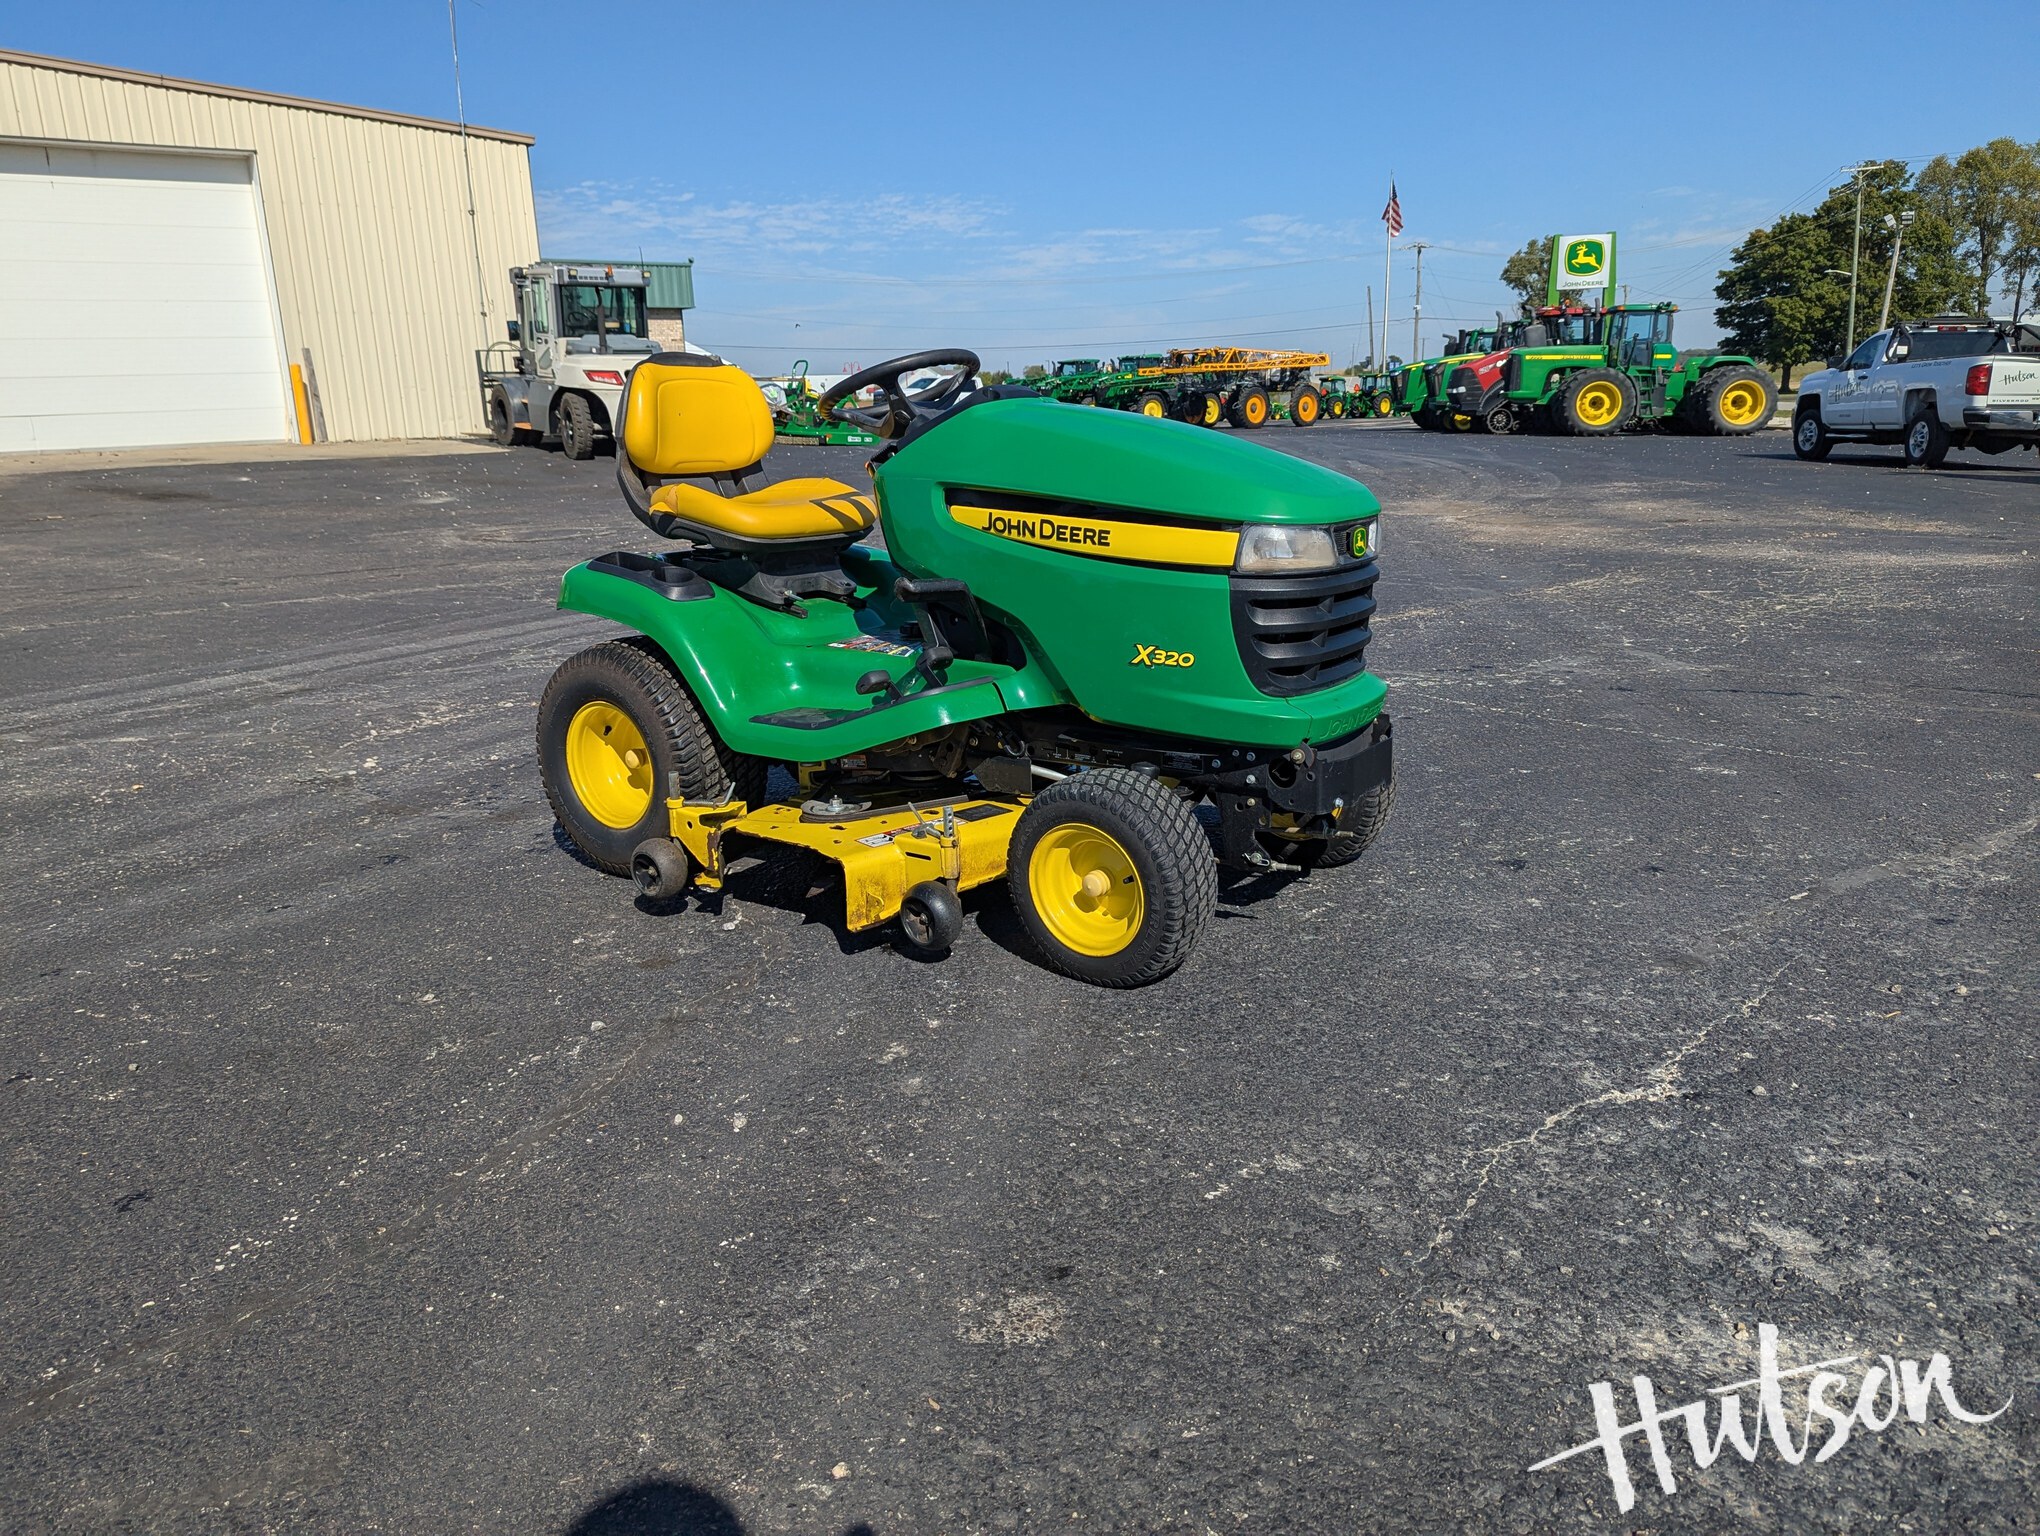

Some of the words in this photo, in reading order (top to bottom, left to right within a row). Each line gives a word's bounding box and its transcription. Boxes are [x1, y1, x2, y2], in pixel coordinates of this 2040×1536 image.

[1998, 370, 2039, 385] Hutson
[982, 511, 1036, 538] JOHN
[1040, 518, 1111, 547] DEERE
[1130, 643, 1195, 668] X320
